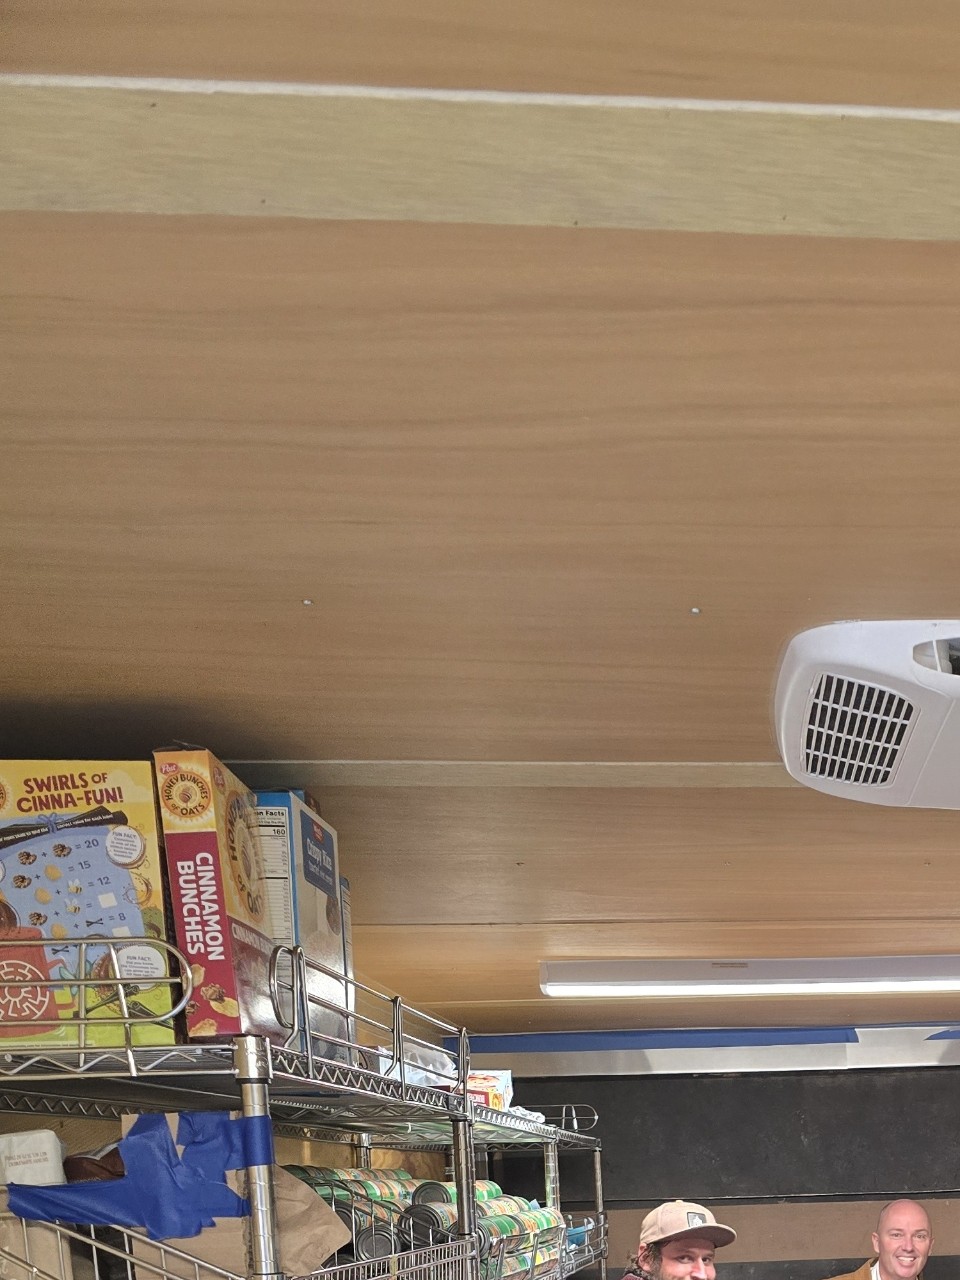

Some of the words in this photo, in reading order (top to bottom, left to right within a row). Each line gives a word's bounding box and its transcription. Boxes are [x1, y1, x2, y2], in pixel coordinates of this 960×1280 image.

[161, 764, 178, 774] Post
[23, 772, 89, 795] SWIRLS
[91, 772, 108, 785] OF
[165, 776, 179, 801] HONEY
[179, 773, 209, 801] BUNCHES
[16, 786, 124, 813] CINNA-FUN!
[180, 803, 206, 817] OATS
[84, 838, 99, 849] 20
[78, 860, 91, 871] 15
[97, 876, 111, 887] 12
[176, 860, 205, 955] BUNCHES
[195, 853, 226, 961] CINNAMON
[118, 912, 126, 922] 8
